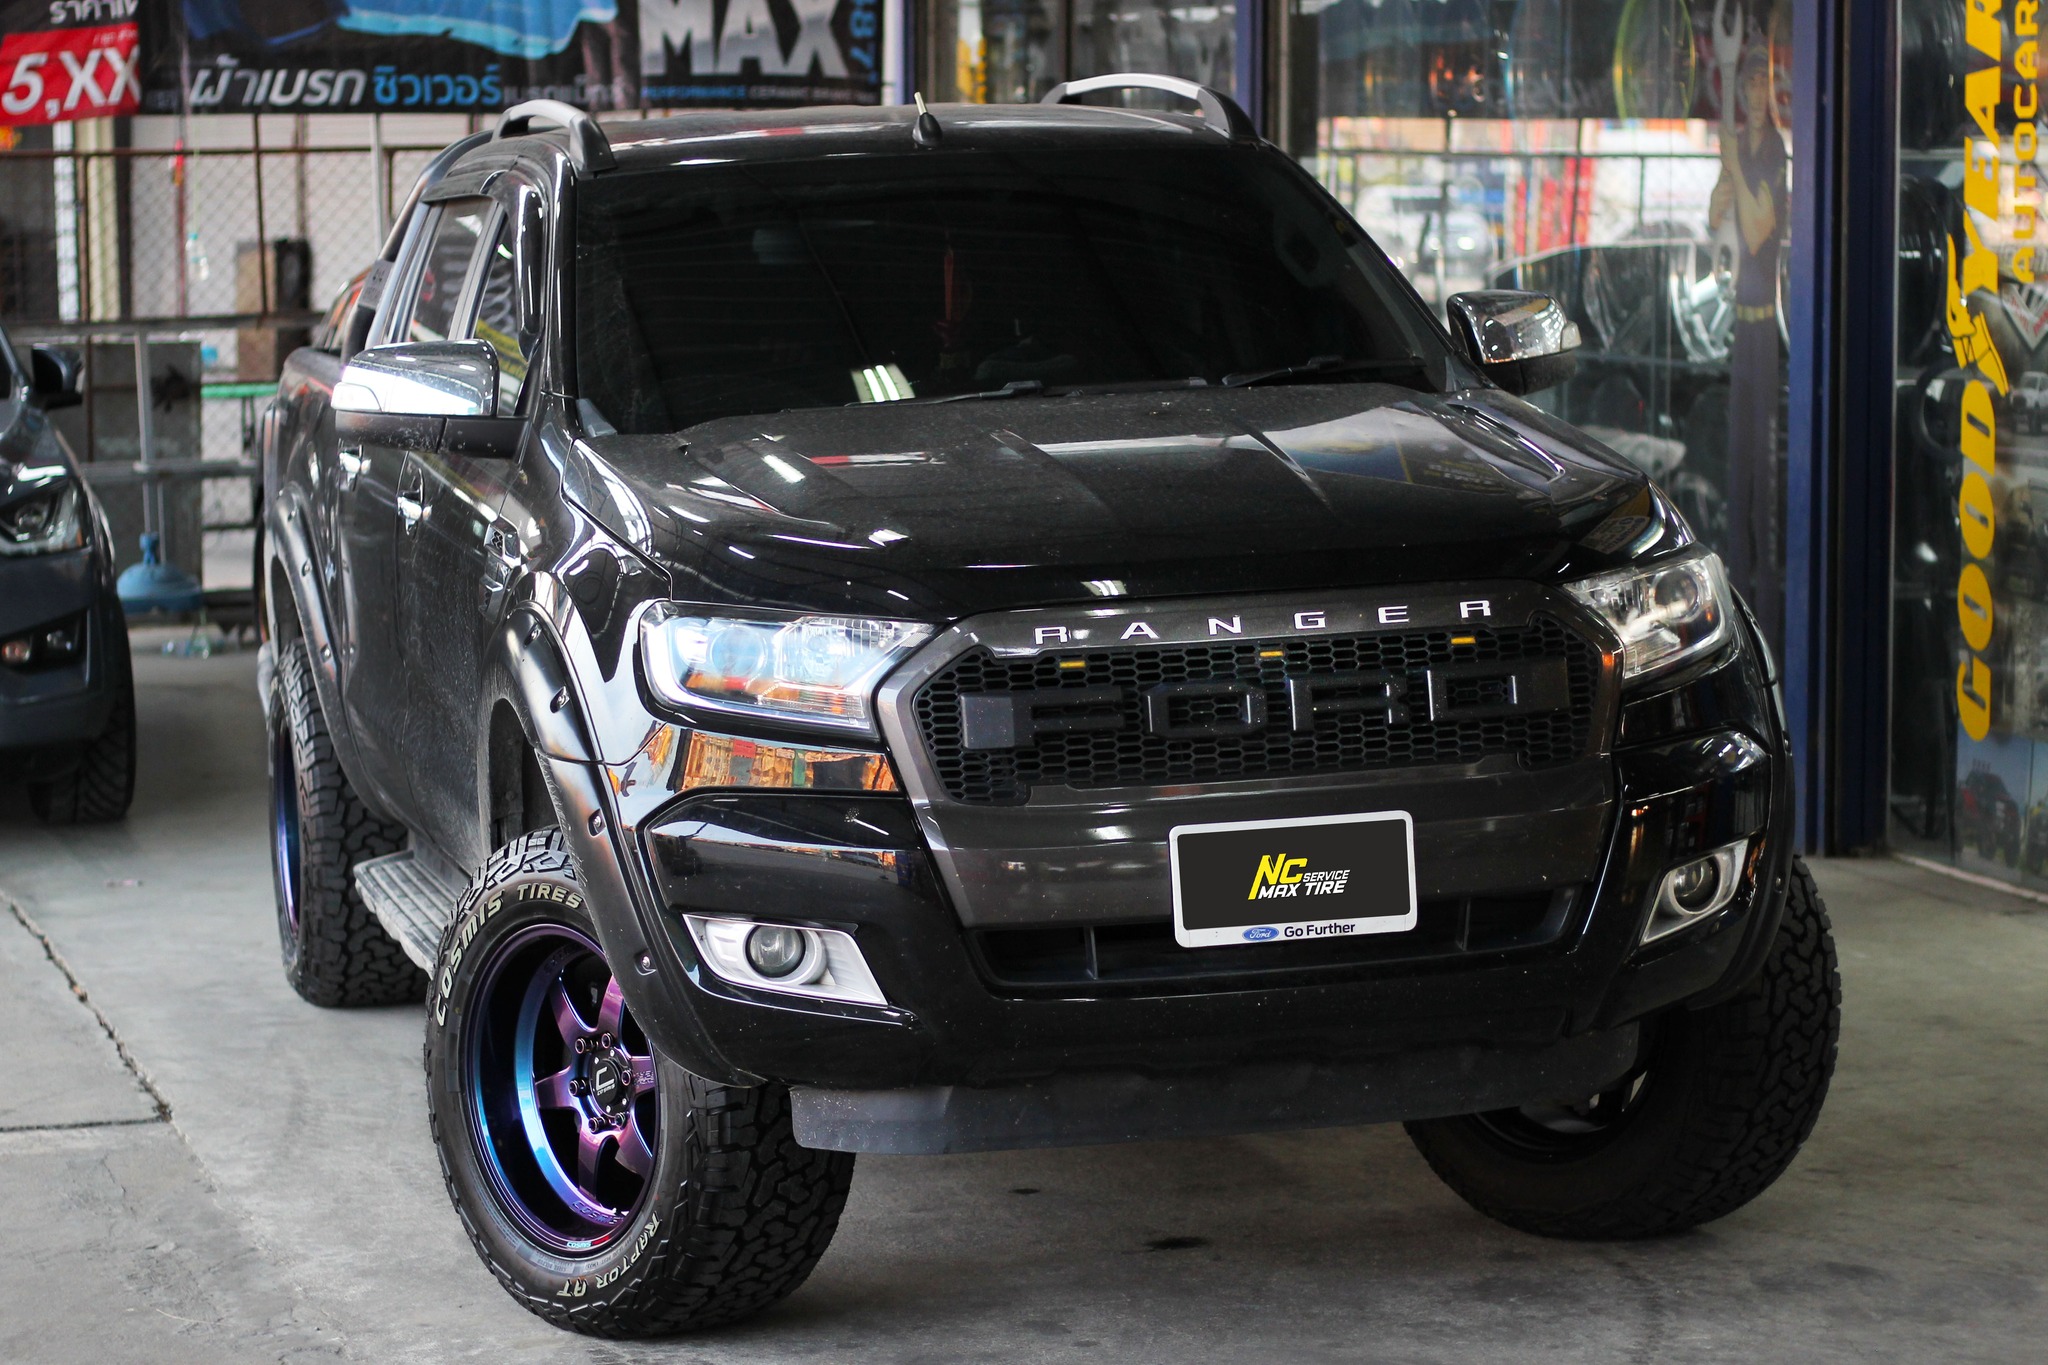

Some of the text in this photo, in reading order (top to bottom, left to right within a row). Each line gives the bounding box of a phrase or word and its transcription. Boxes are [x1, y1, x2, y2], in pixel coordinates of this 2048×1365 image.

[641, 0, 849, 77] MAX
[189, 54, 367, 107] ผ้าเบรก
[1033, 600, 1493, 645] RANGER
[960, 656, 1570, 751] FORD
[436, 883, 585, 1026] COSMIS TIRES
[1284, 926, 1304, 938] Go
[1307, 922, 1356, 936] Further
[595, 1211, 660, 1289] RAPTOR
